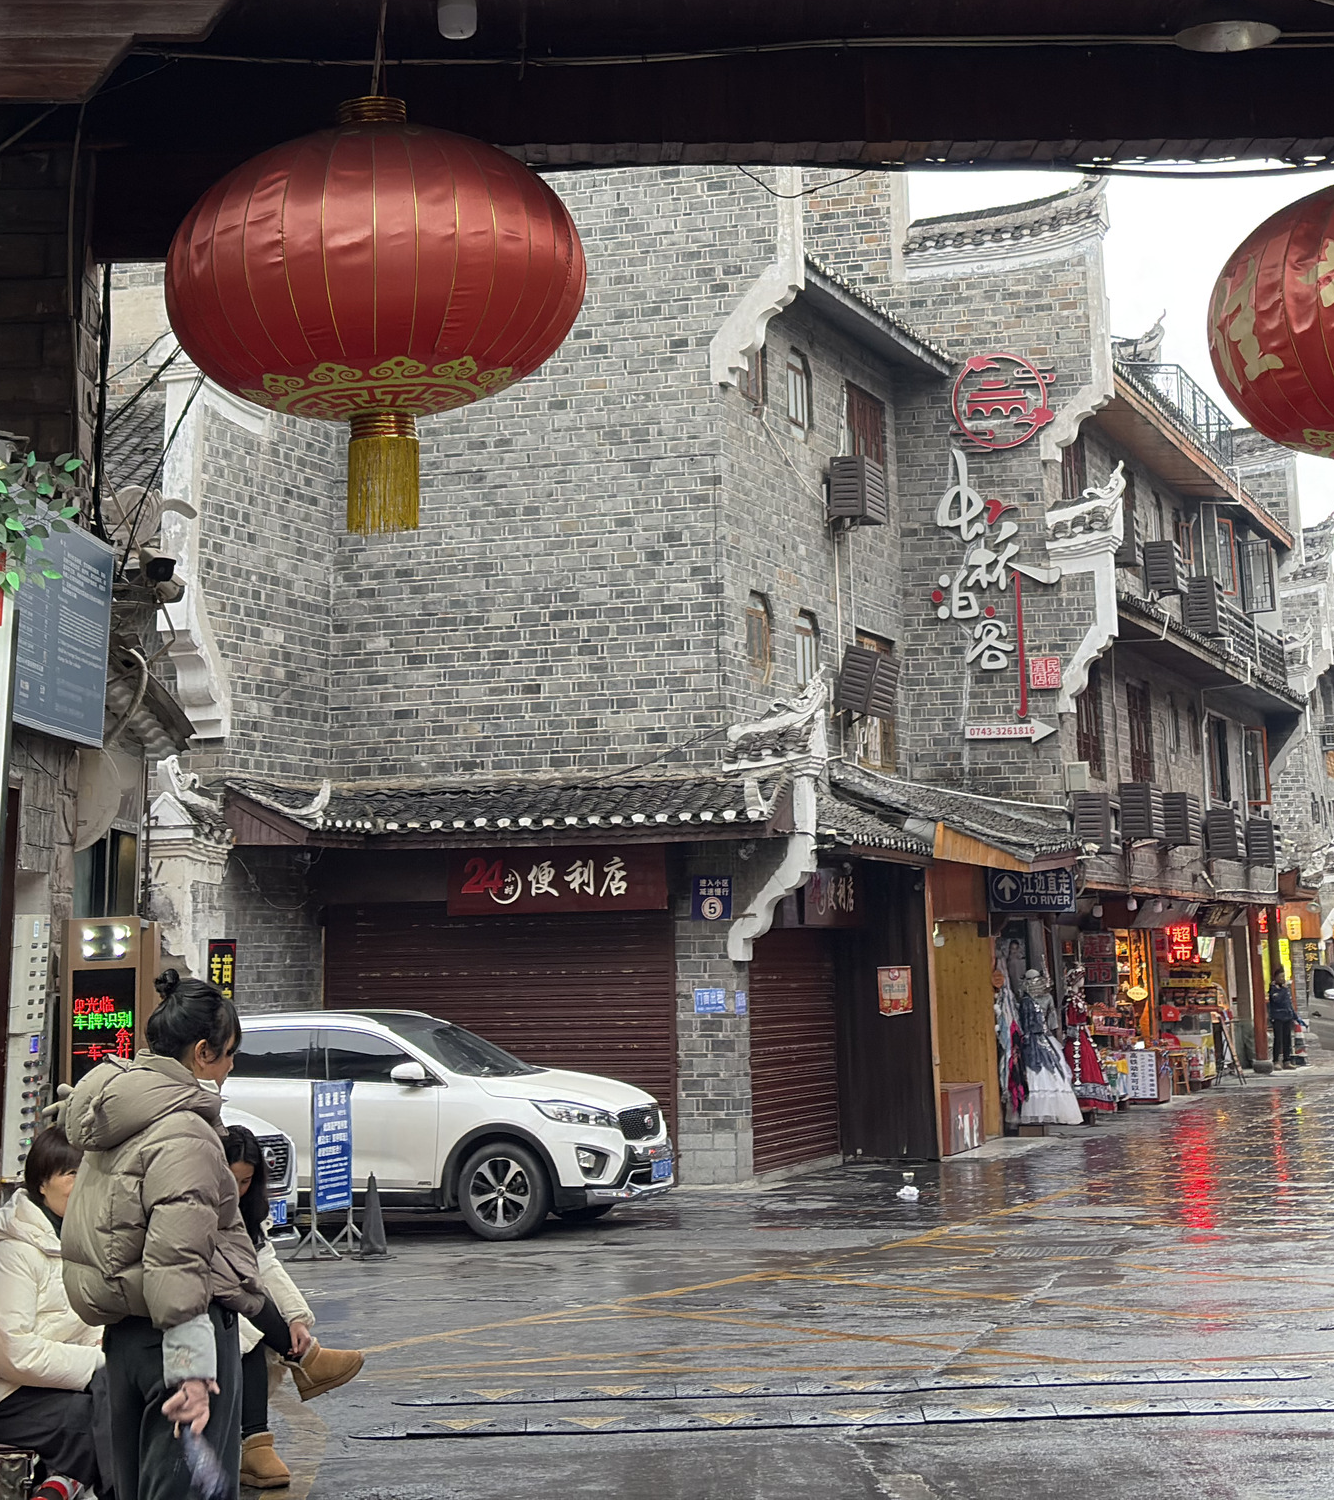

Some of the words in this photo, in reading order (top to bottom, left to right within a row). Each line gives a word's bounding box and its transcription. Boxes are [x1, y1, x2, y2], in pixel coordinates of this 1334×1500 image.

[969, 725, 1036, 738] 0743-3261816
[1022, 871, 1071, 893] 江边直走
[1024, 895, 1038, 905] TO
[1040, 894, 1071, 905] RIVER
[708, 902, 717, 915] 5
[1172, 926, 1193, 961] 超市
[73, 1011, 132, 1030] 车牌识别
[72, 1044, 132, 1061] 一车一杆
